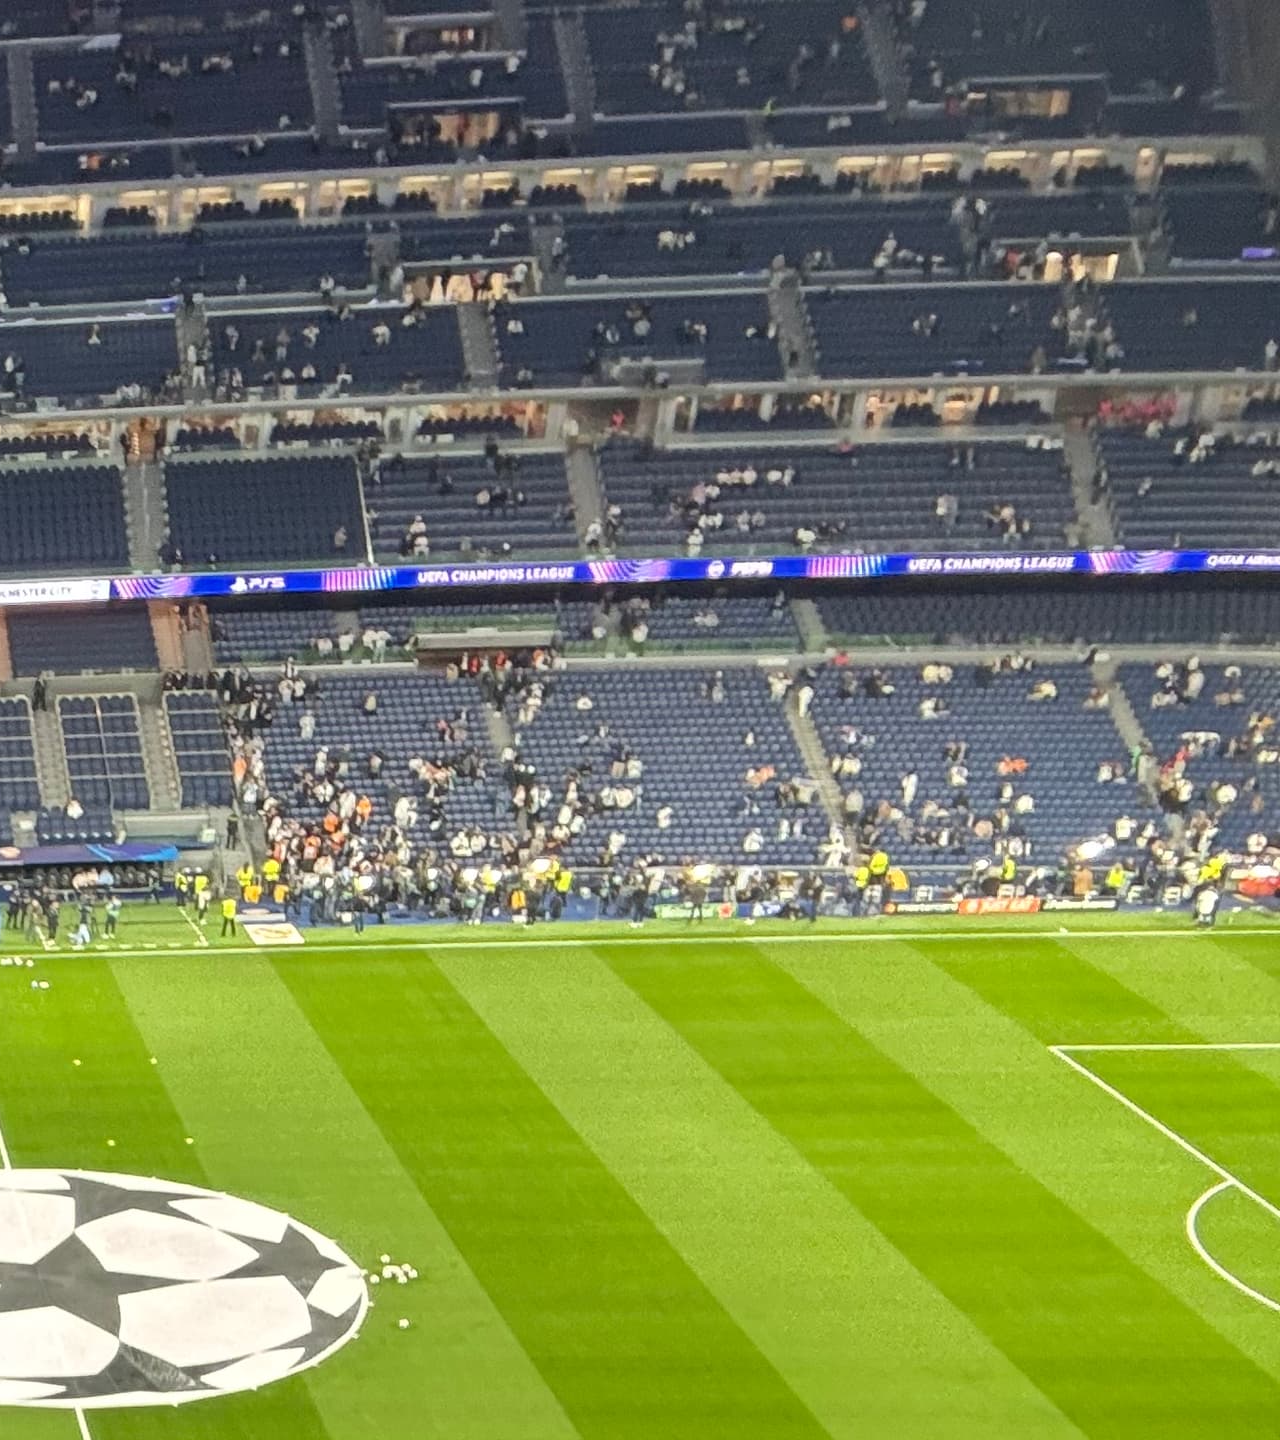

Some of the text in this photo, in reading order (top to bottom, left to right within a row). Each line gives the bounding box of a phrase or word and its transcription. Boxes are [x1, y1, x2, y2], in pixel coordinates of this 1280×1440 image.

[909, 556, 1075, 571] UEFA CHAMPIONS LEAGUE
[417, 566, 575, 583] UEFA CHAMPIONS LEAGUE
